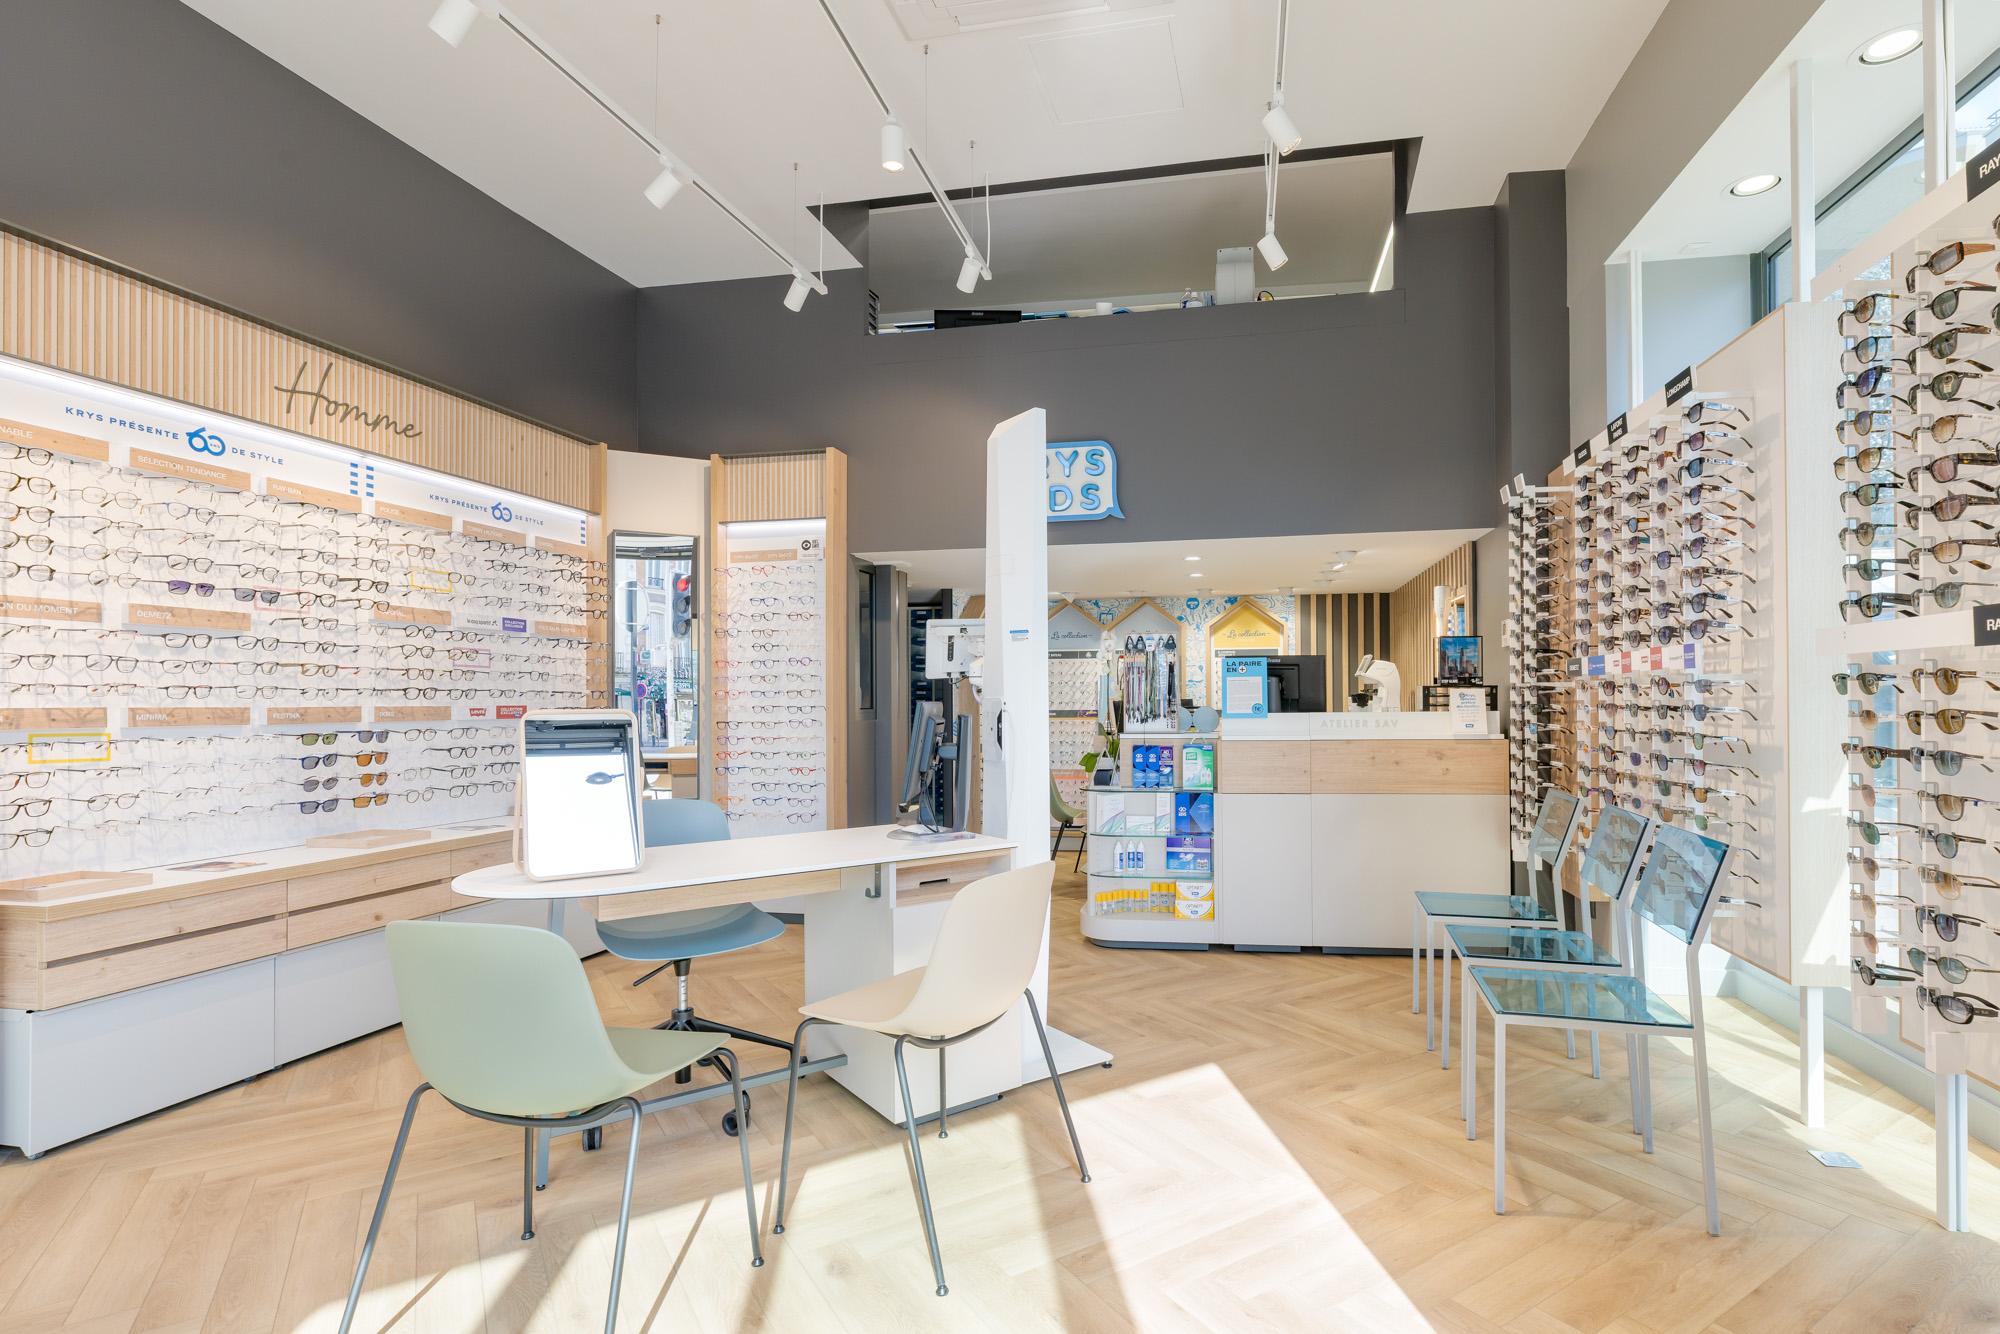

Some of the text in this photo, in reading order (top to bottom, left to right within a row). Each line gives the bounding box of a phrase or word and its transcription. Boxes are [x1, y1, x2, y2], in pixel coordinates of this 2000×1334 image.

[273, 360, 423, 439] Homme
[65, 406, 104, 422] KRYS
[109, 416, 180, 440] PRÉSENTE
[231, 446, 247, 456] DE
[249, 450, 285, 465] STYLE
[186, 464, 229, 480] TENDANCE
[429, 493, 450, 503] KRYS
[451, 499, 488, 513] PRÉSENTE
[525, 516, 545, 526] STYLE
[33, 604, 79, 616] MOMENT
[1060, 631, 1088, 639] collection
[1237, 630, 1267, 638] collection
[1238, 660, 1262, 668] PAIRE
[1320, 719, 1399, 729] ATELIER SAV
